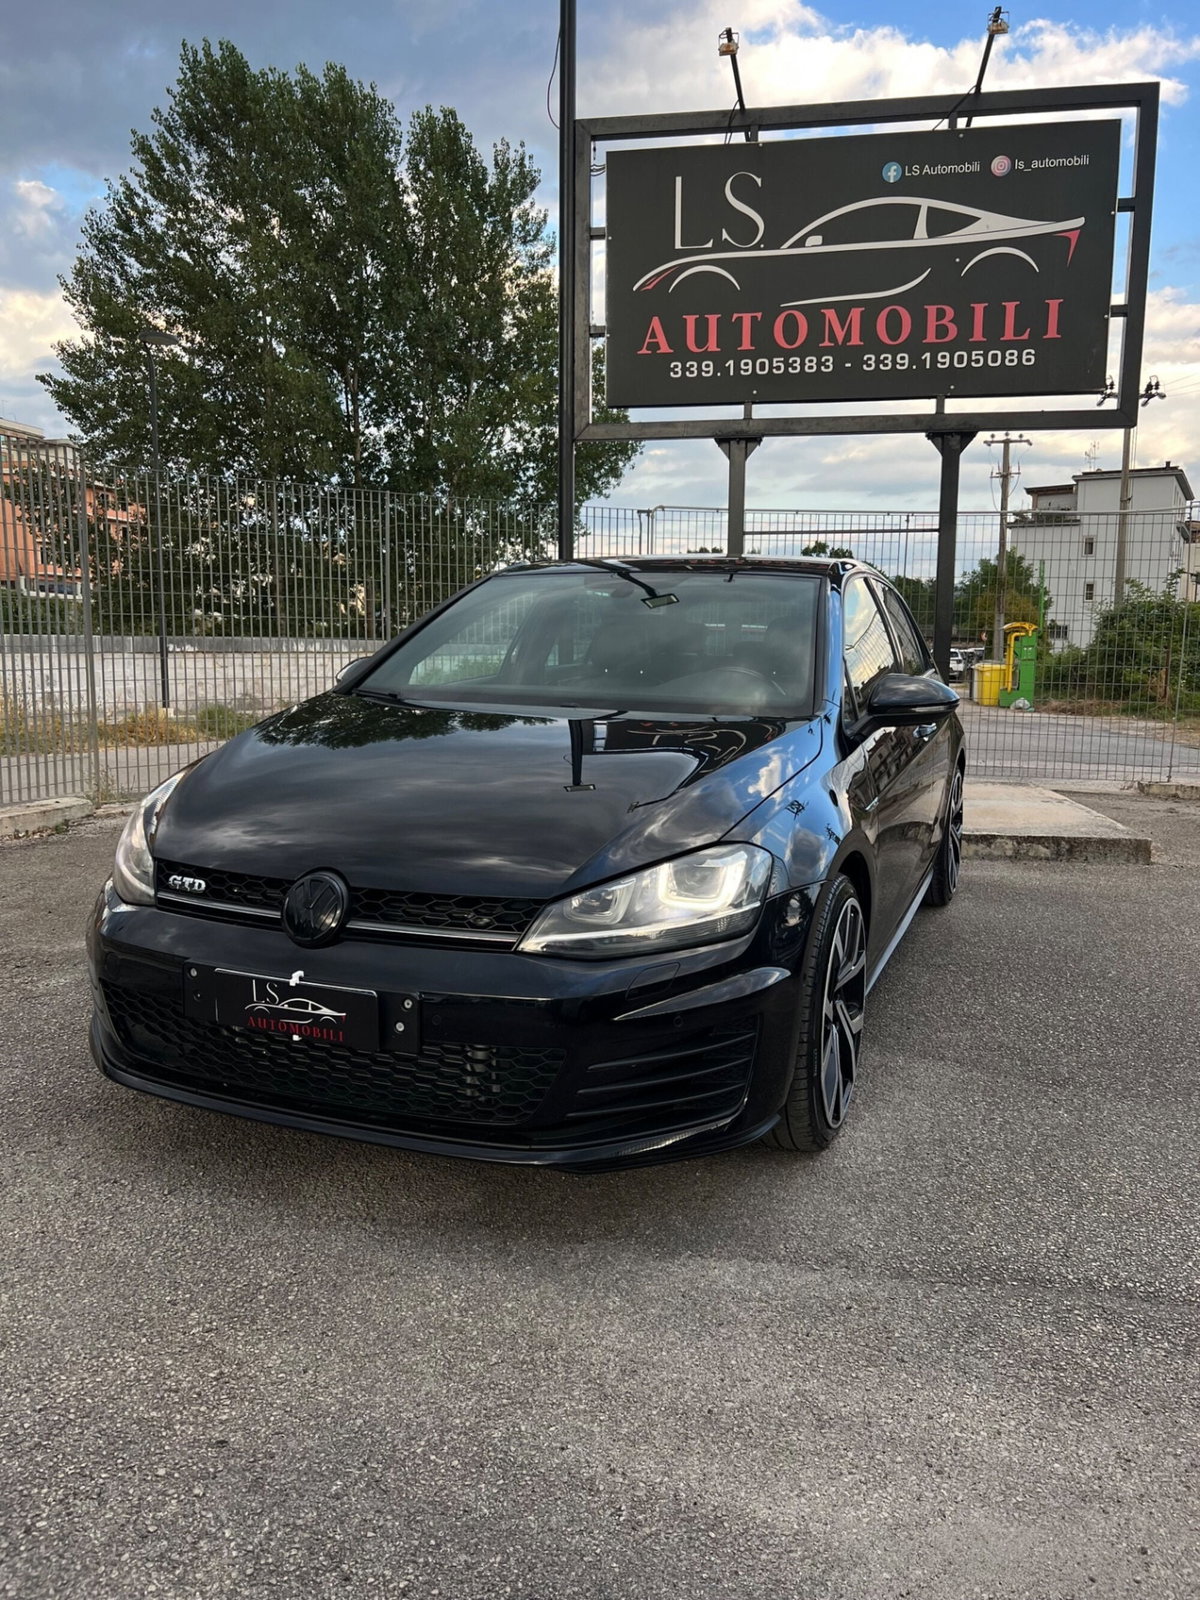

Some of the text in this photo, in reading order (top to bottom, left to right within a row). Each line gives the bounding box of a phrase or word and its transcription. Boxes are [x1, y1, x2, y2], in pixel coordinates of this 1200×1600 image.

[905, 161, 981, 177] LS Automobili
[1014, 154, 1090, 171] ls_automobili
[636, 298, 1064, 354] AUTOMOBILI
[669, 355, 834, 378] 339.1905383
[862, 348, 1036, 371] 339.1905086
[168, 874, 207, 893] GTD
[252, 979, 280, 1005] LS
[247, 1016, 345, 1042] AUTOMOBILI
